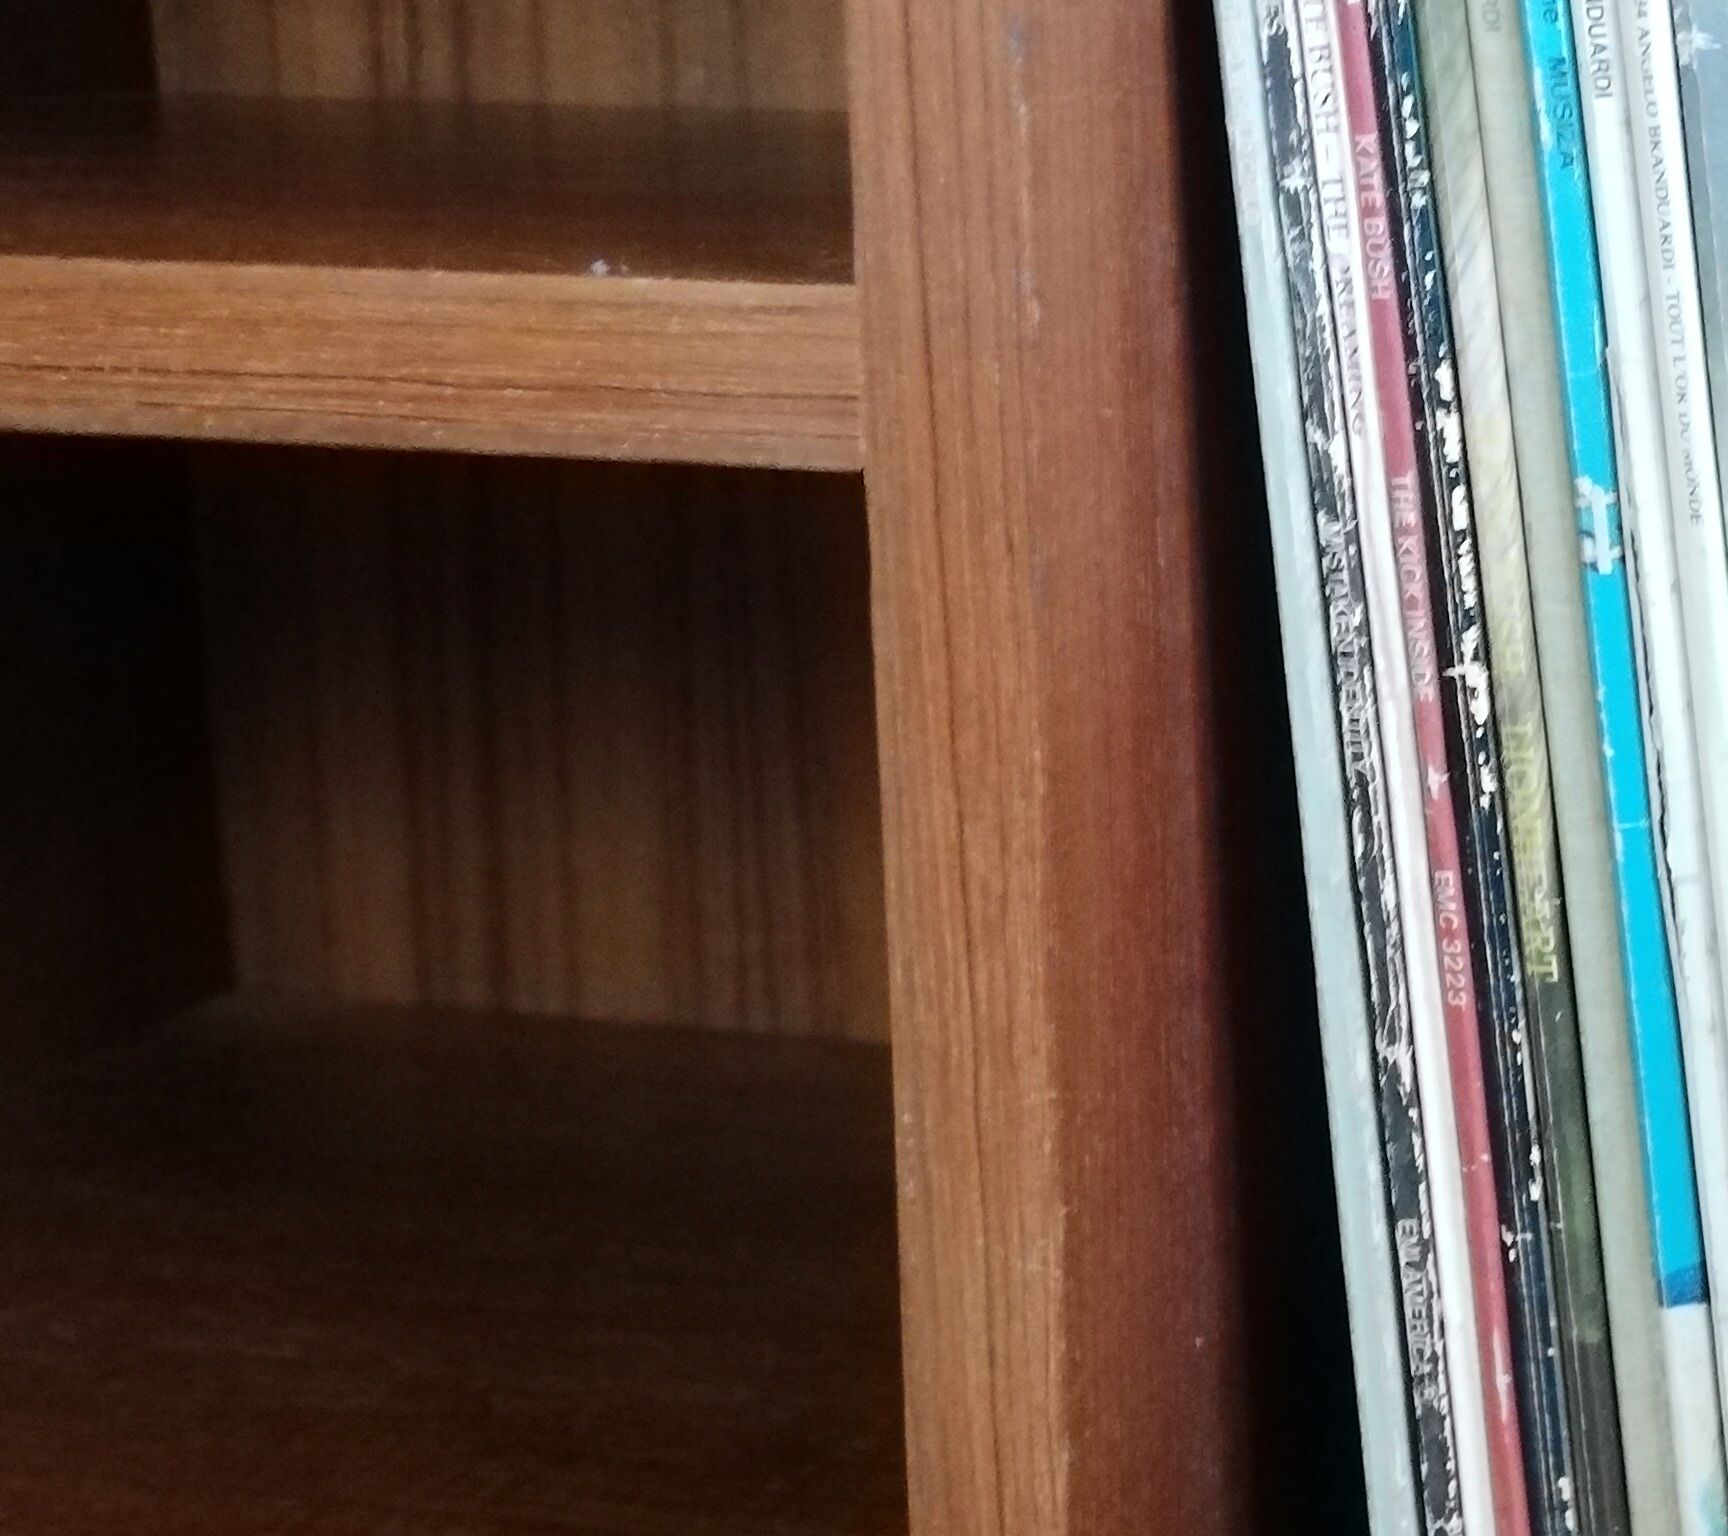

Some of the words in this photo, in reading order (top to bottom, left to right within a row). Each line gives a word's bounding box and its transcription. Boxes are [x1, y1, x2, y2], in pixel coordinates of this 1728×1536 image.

[1634, 26, 1659, 119] ANGELO
[1544, 55, 1579, 171] MUSIZA
[1352, 132, 1382, 208] KATE
[1645, 126, 1676, 271] BRANDUARDI
[1361, 217, 1392, 301] BUSH
[1663, 291, 1684, 349] TOUT
[1388, 472, 1416, 526] THE
[1395, 533, 1423, 600] KICK
[1404, 607, 1434, 701] INSIDE
[1432, 869, 1459, 929] EMC
[1439, 937, 1467, 1007] 3223
